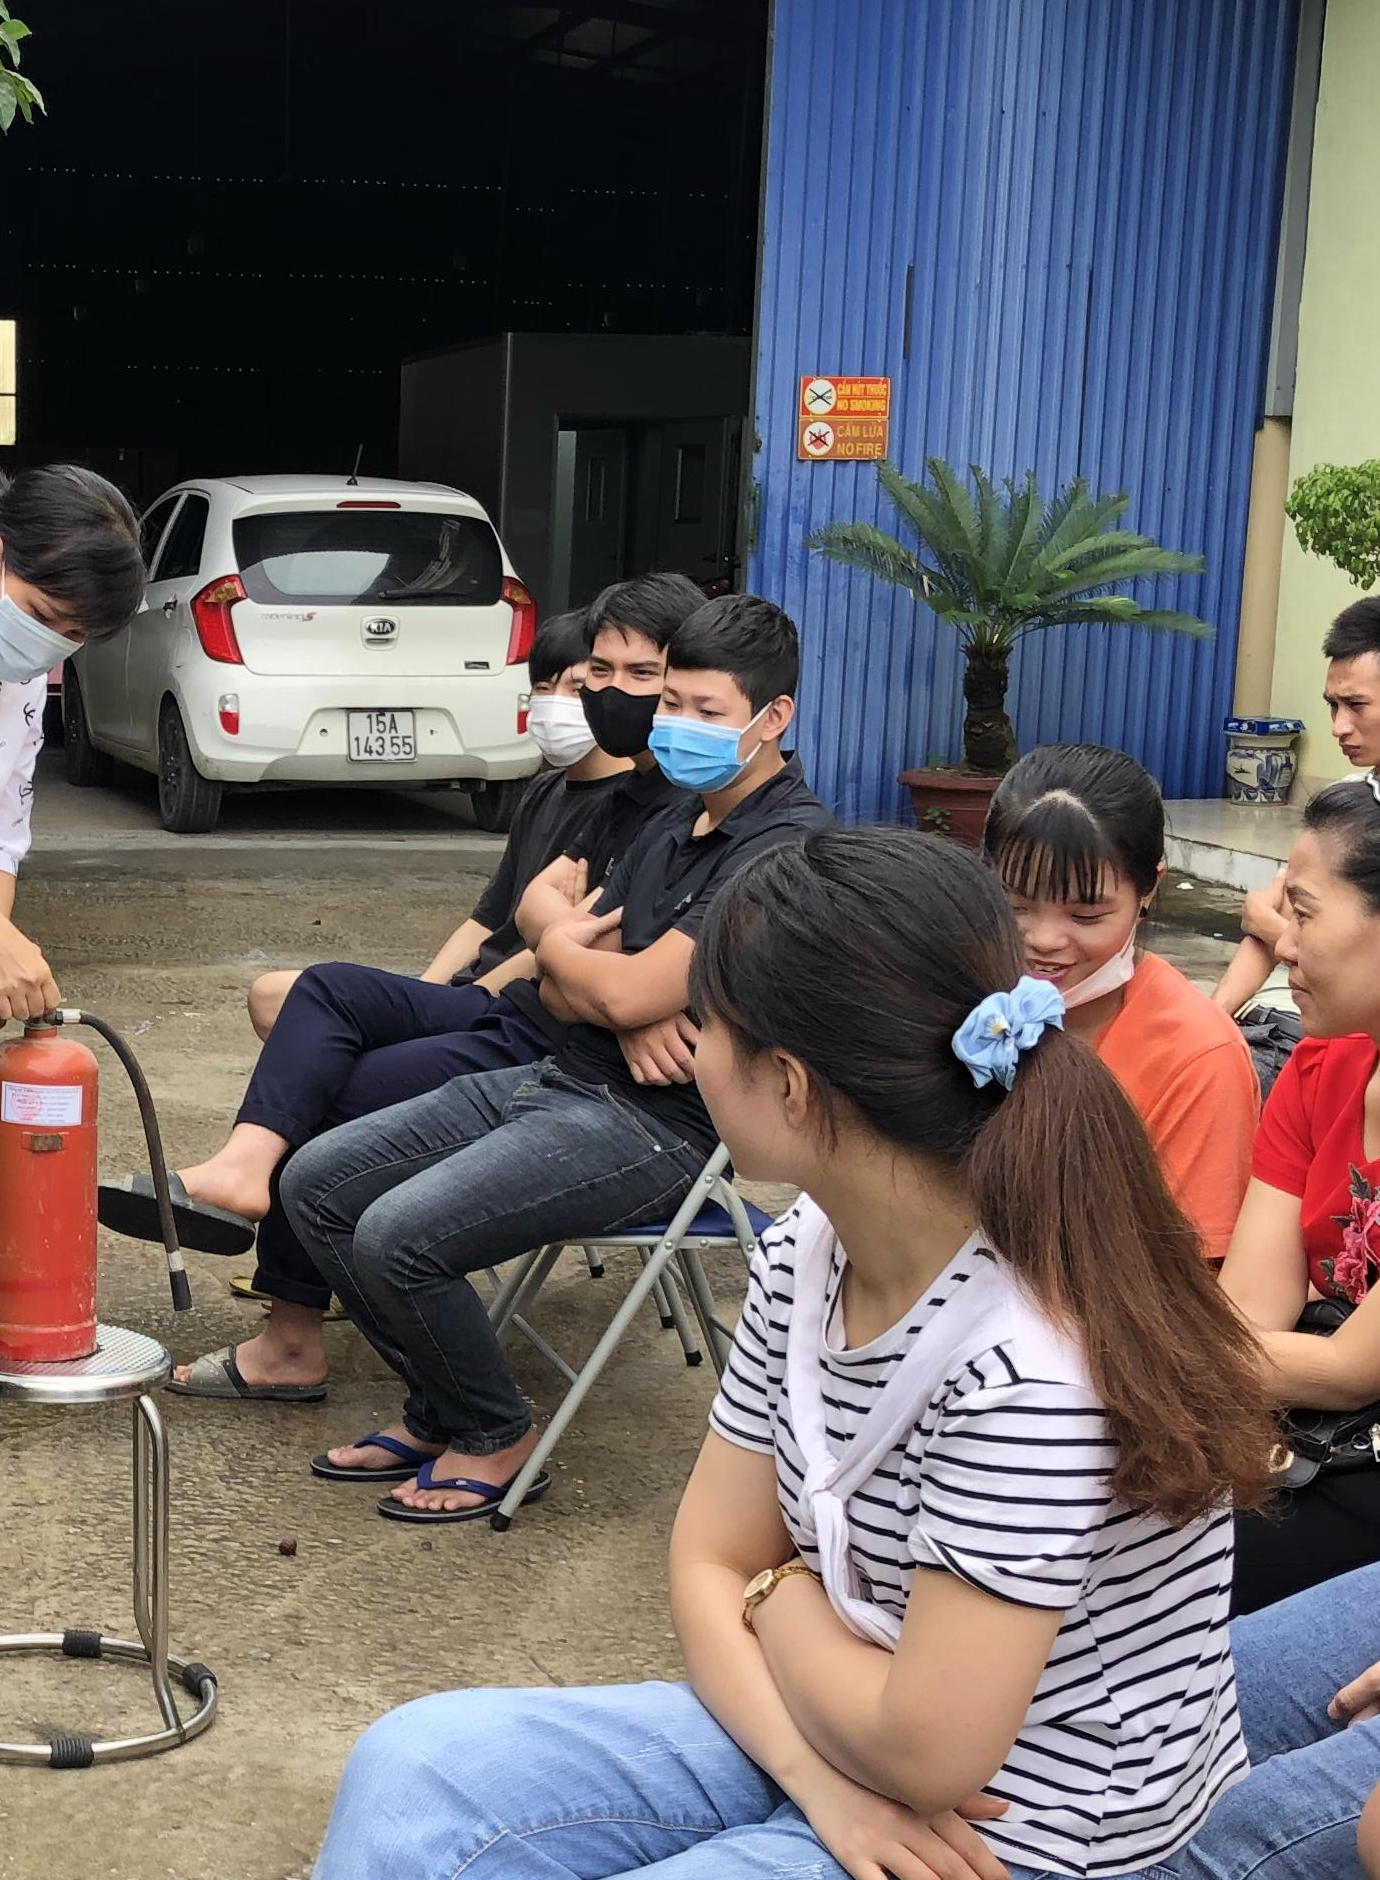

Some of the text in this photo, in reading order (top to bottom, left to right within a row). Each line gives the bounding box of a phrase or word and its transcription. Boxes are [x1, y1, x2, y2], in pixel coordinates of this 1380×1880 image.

[837, 399, 886, 411] NO SMOKING
[836, 442, 882, 456] NO FIRE
[370, 622, 392, 633] KIA
[366, 713, 398, 734] 15A
